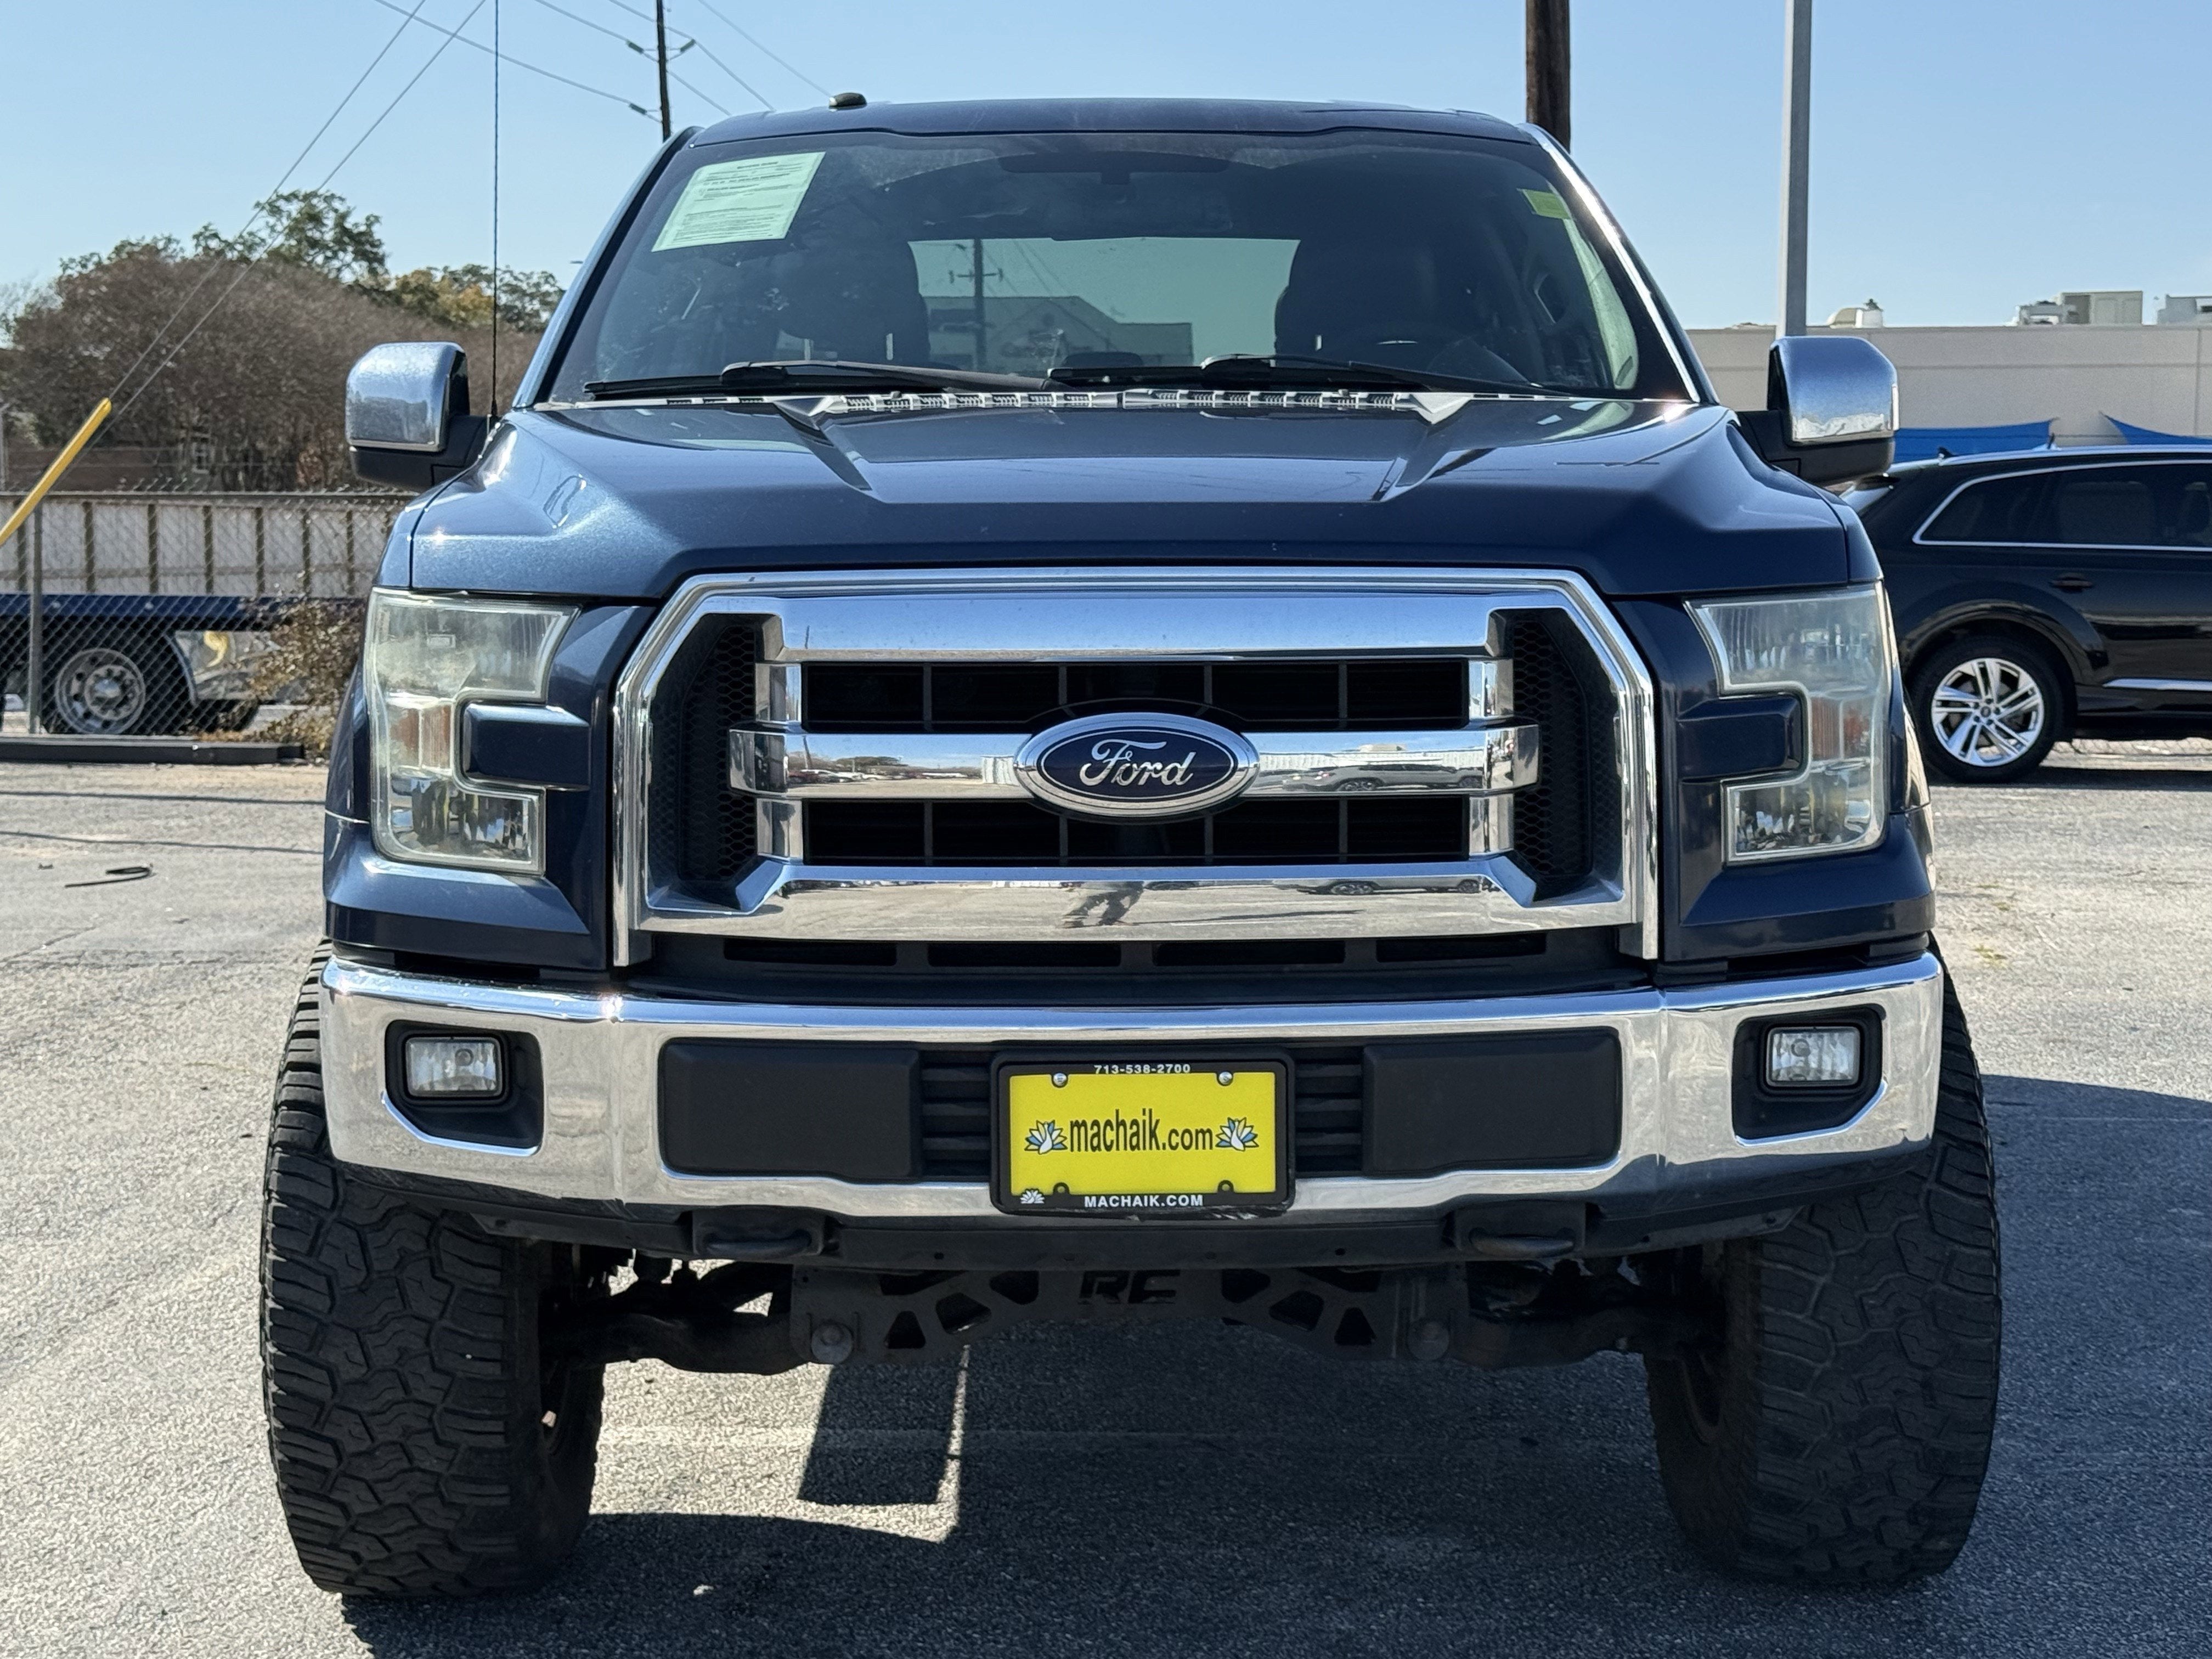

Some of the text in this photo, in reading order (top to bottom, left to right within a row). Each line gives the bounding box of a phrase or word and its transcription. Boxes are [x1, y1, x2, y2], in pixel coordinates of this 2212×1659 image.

[1080, 738, 1197, 786] Ford
[1094, 1064, 1190, 1074] 713-538-2700
[1070, 1108, 1213, 1152] machaik.com
[1084, 1194, 1203, 1207] MACHAIK.COM
